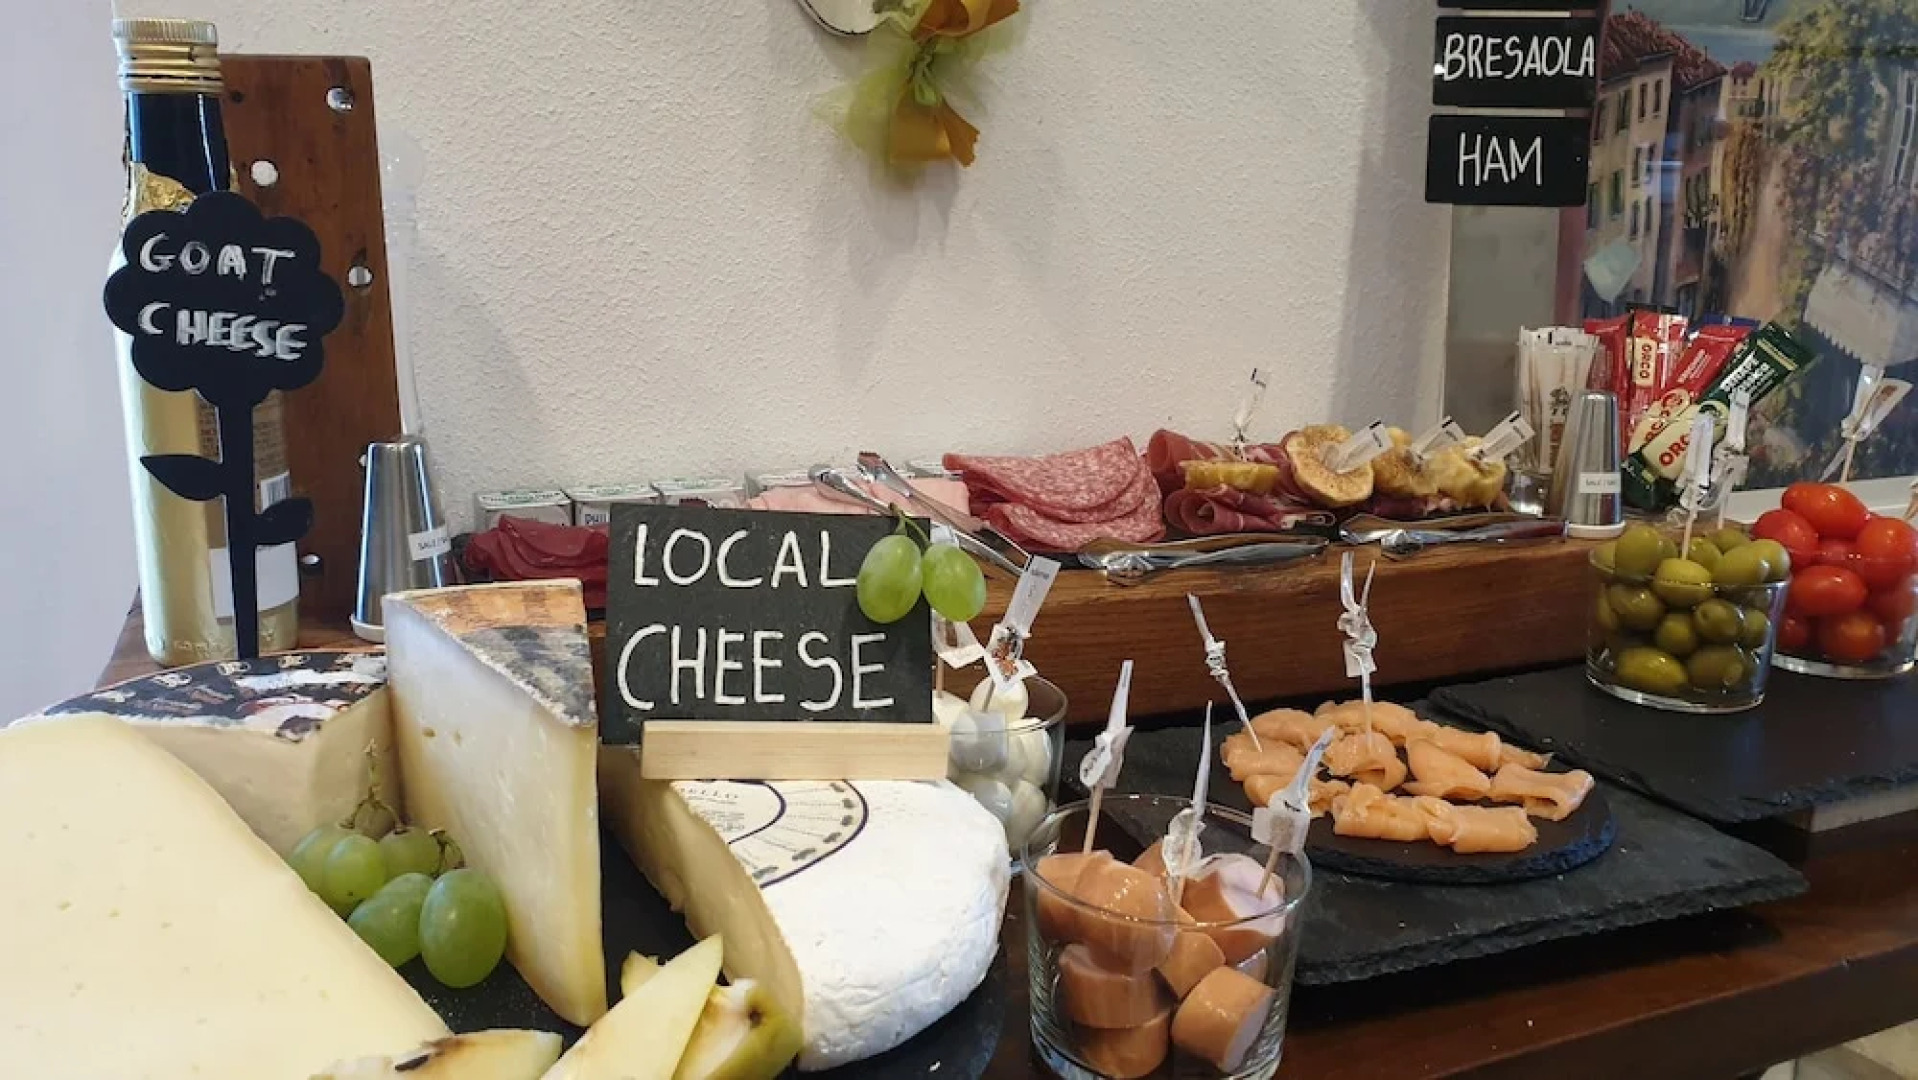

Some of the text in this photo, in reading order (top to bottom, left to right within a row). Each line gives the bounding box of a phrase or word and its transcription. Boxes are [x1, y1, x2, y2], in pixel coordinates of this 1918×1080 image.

[1442, 33, 1596, 80] BRESAOLA
[1459, 132, 1544, 188] HAM
[139, 233, 295, 285] GOAT
[137, 302, 308, 361] CHEESE
[634, 523, 857, 588] LOCAL
[617, 624, 895, 711] CHEESE
